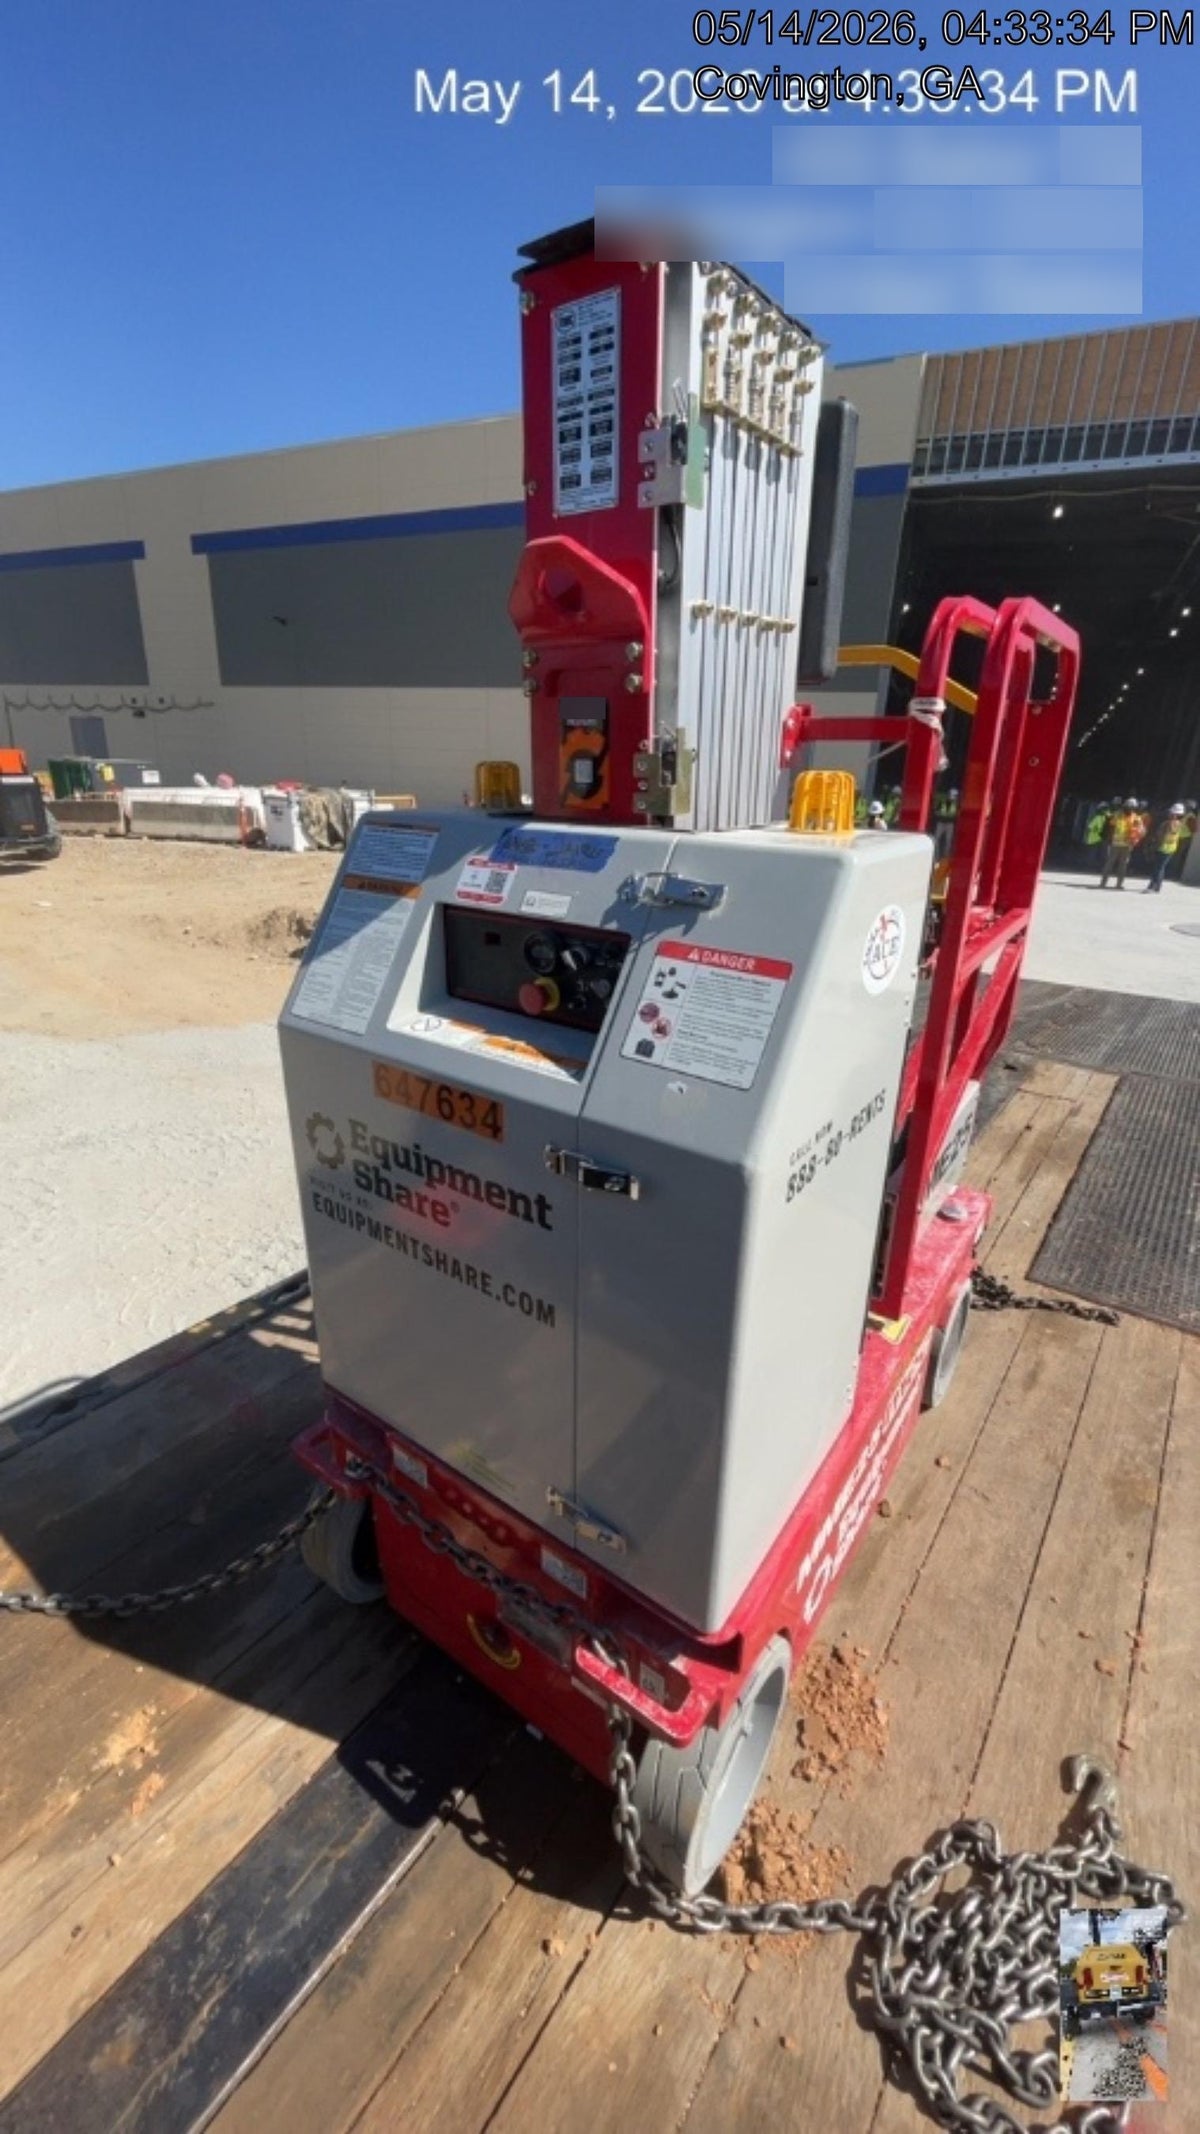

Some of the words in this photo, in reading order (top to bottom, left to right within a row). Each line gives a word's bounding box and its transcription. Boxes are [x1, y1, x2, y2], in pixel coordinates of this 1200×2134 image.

[702, 951, 755, 970] DANGER
[375, 1063, 503, 1139] 647634
[348, 1118, 553, 1231] Equipment
[313, 1192, 556, 1328] EQUIPMENTSHARE.COM
